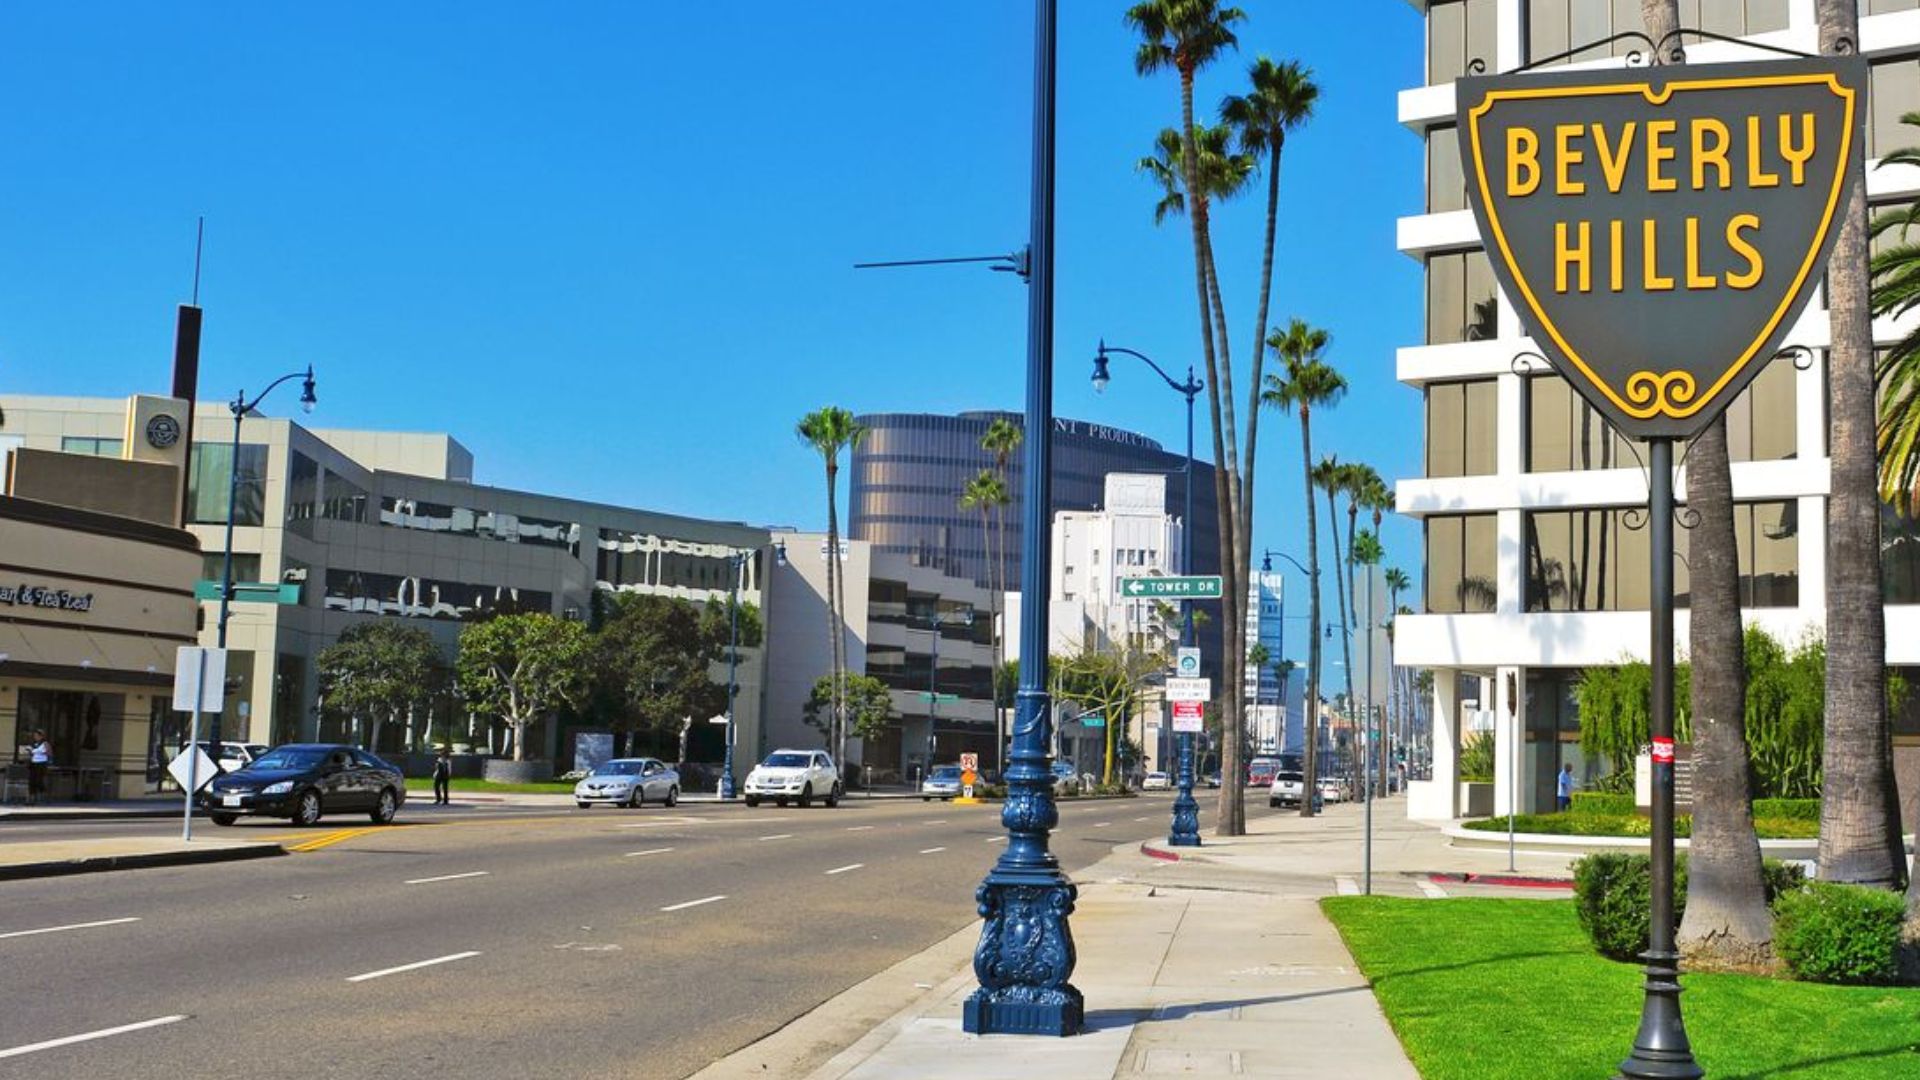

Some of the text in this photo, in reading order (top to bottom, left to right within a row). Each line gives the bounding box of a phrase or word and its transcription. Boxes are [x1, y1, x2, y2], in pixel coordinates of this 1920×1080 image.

[1506, 113, 1815, 197] BEVERLY
[1554, 214, 1764, 292] HILLS
[0, 588, 18, 602] an
[22, 586, 34, 604] &
[35, 588, 60, 607] Tea
[1150, 582, 1214, 592] TOWER DR
